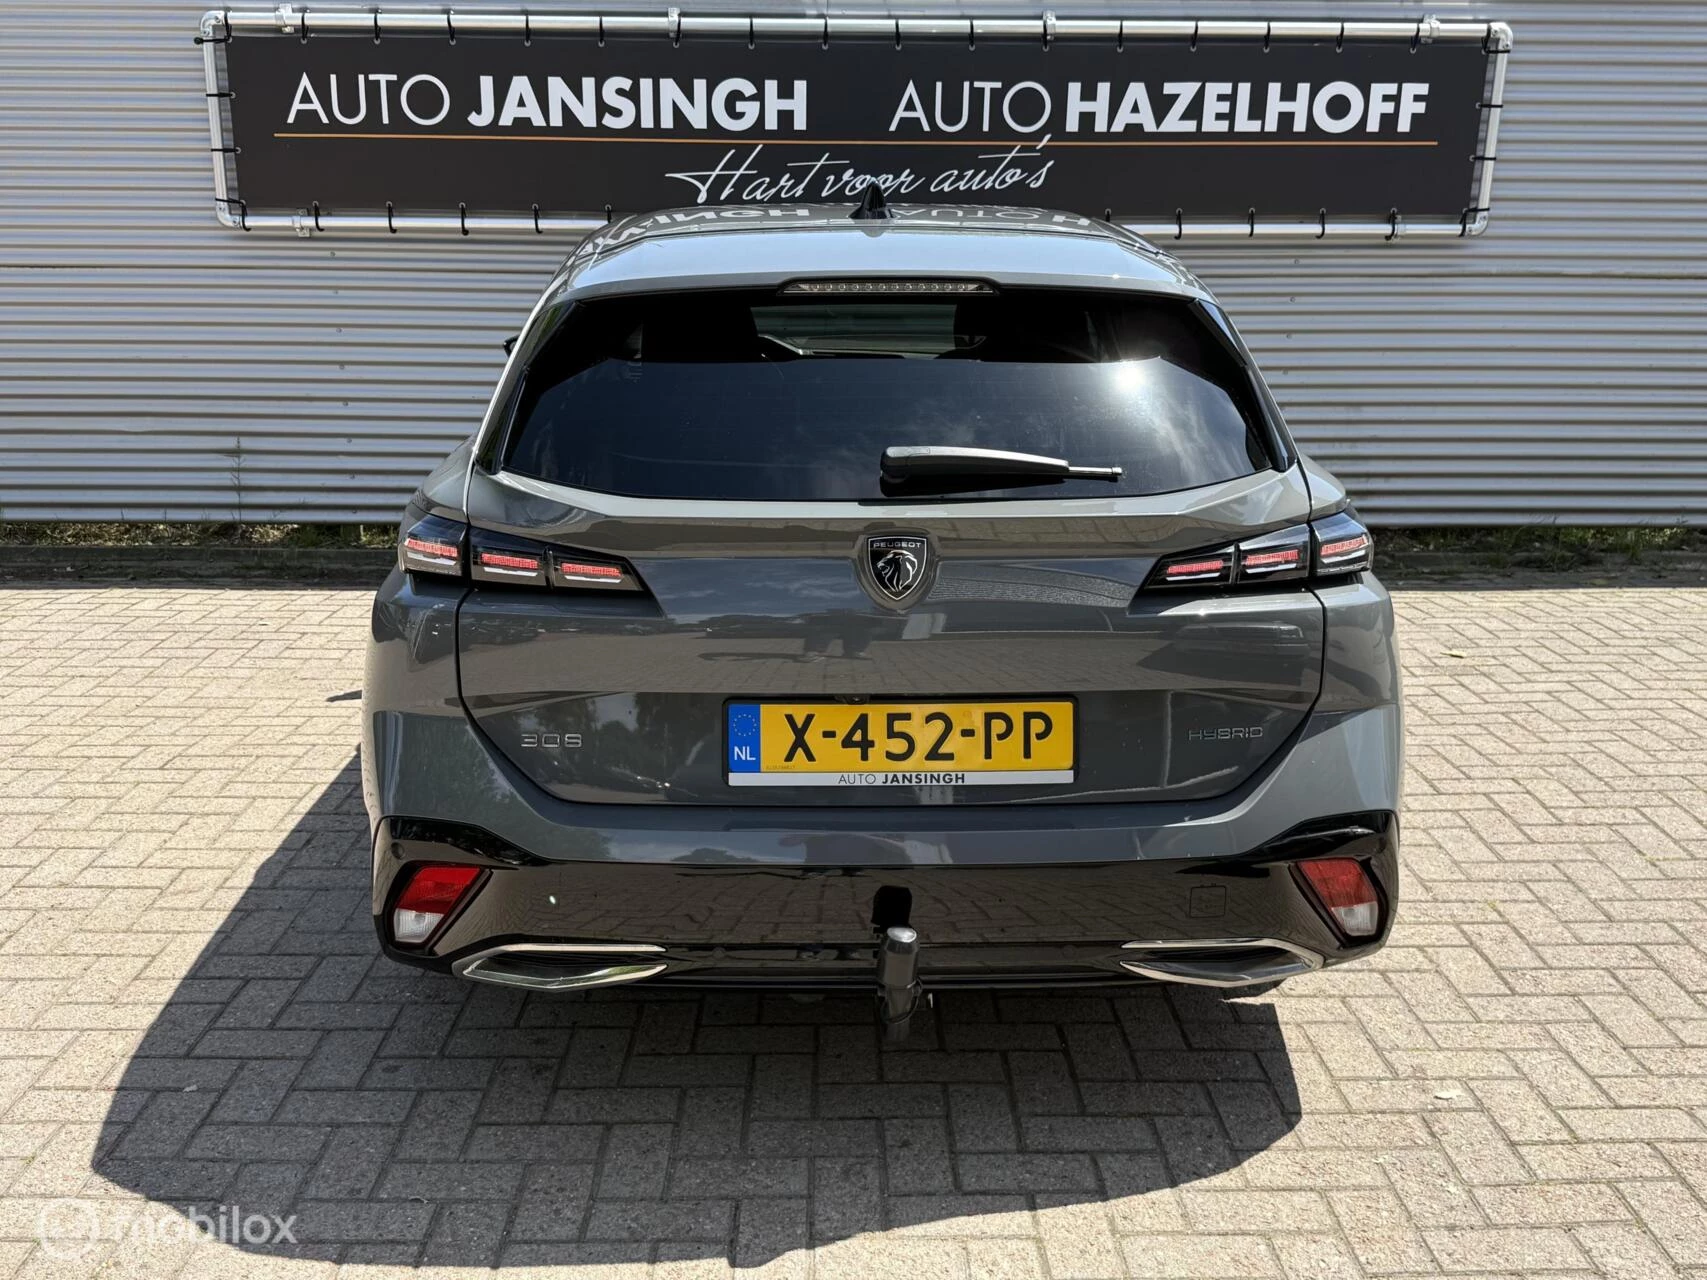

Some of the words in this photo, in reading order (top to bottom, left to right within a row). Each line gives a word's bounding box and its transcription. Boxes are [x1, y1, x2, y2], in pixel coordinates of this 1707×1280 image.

[286, 71, 450, 126] AUTO
[466, 75, 807, 131] JANSINGH
[888, 79, 1051, 134] AUTO
[1065, 81, 1430, 134] HAZELHOFF
[664, 144, 850, 204] Hart
[873, 541, 922, 549] PEUGEOT
[783, 711, 1054, 763] X-452-PP
[1188, 726, 1264, 741] HYBRID
[733, 746, 757, 761] NL
[838, 773, 877, 785] AUTO
[881, 773, 966, 785] JANSINGH
